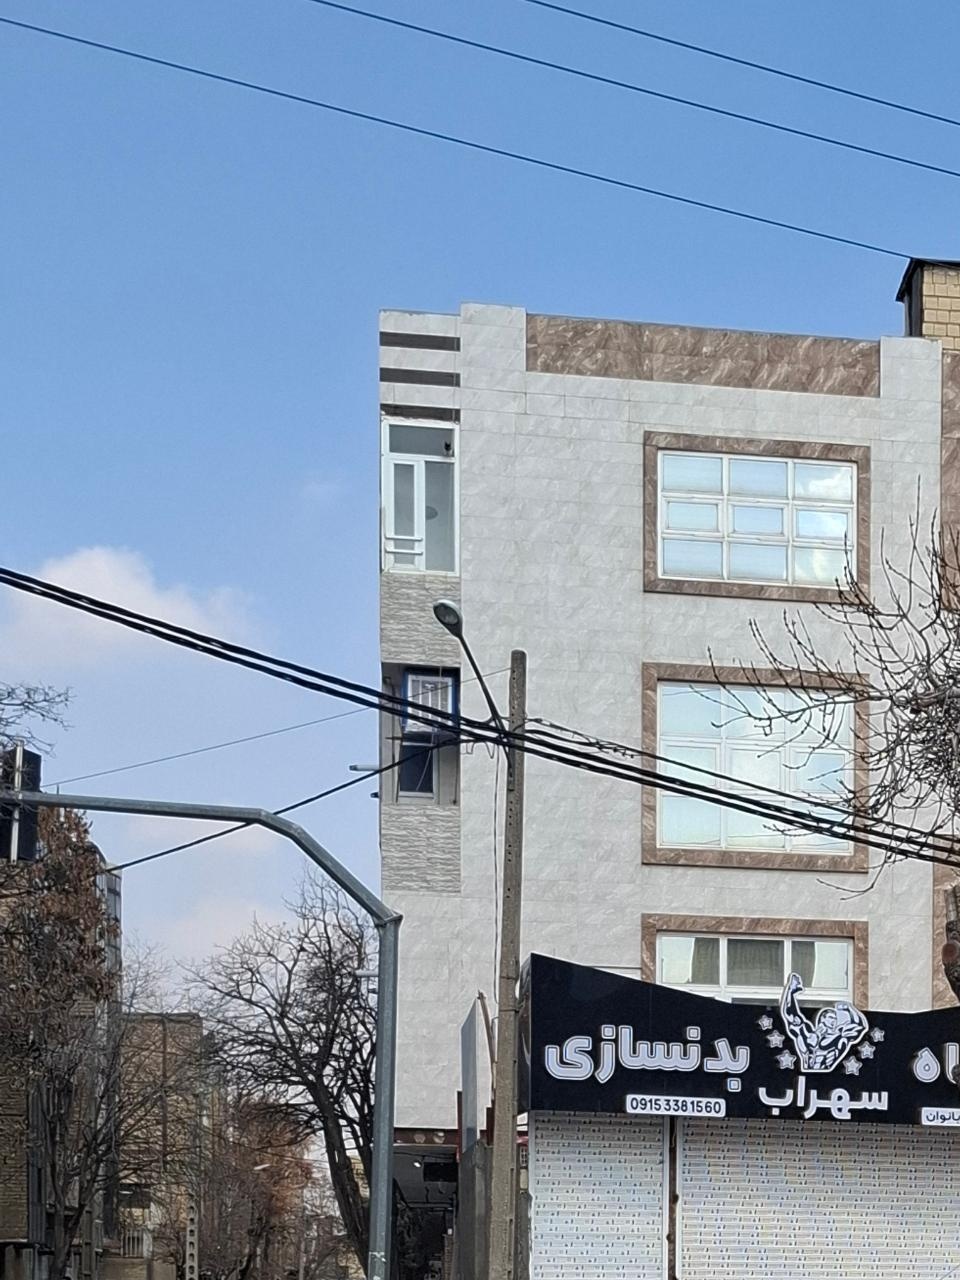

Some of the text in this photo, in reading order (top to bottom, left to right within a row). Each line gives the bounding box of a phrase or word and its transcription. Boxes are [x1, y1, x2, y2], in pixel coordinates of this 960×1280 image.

[544, 1023, 751, 1093] بدنسازی
[629, 1097, 722, 1115] 09153381560
[758, 1075, 889, 1121] سهراب
